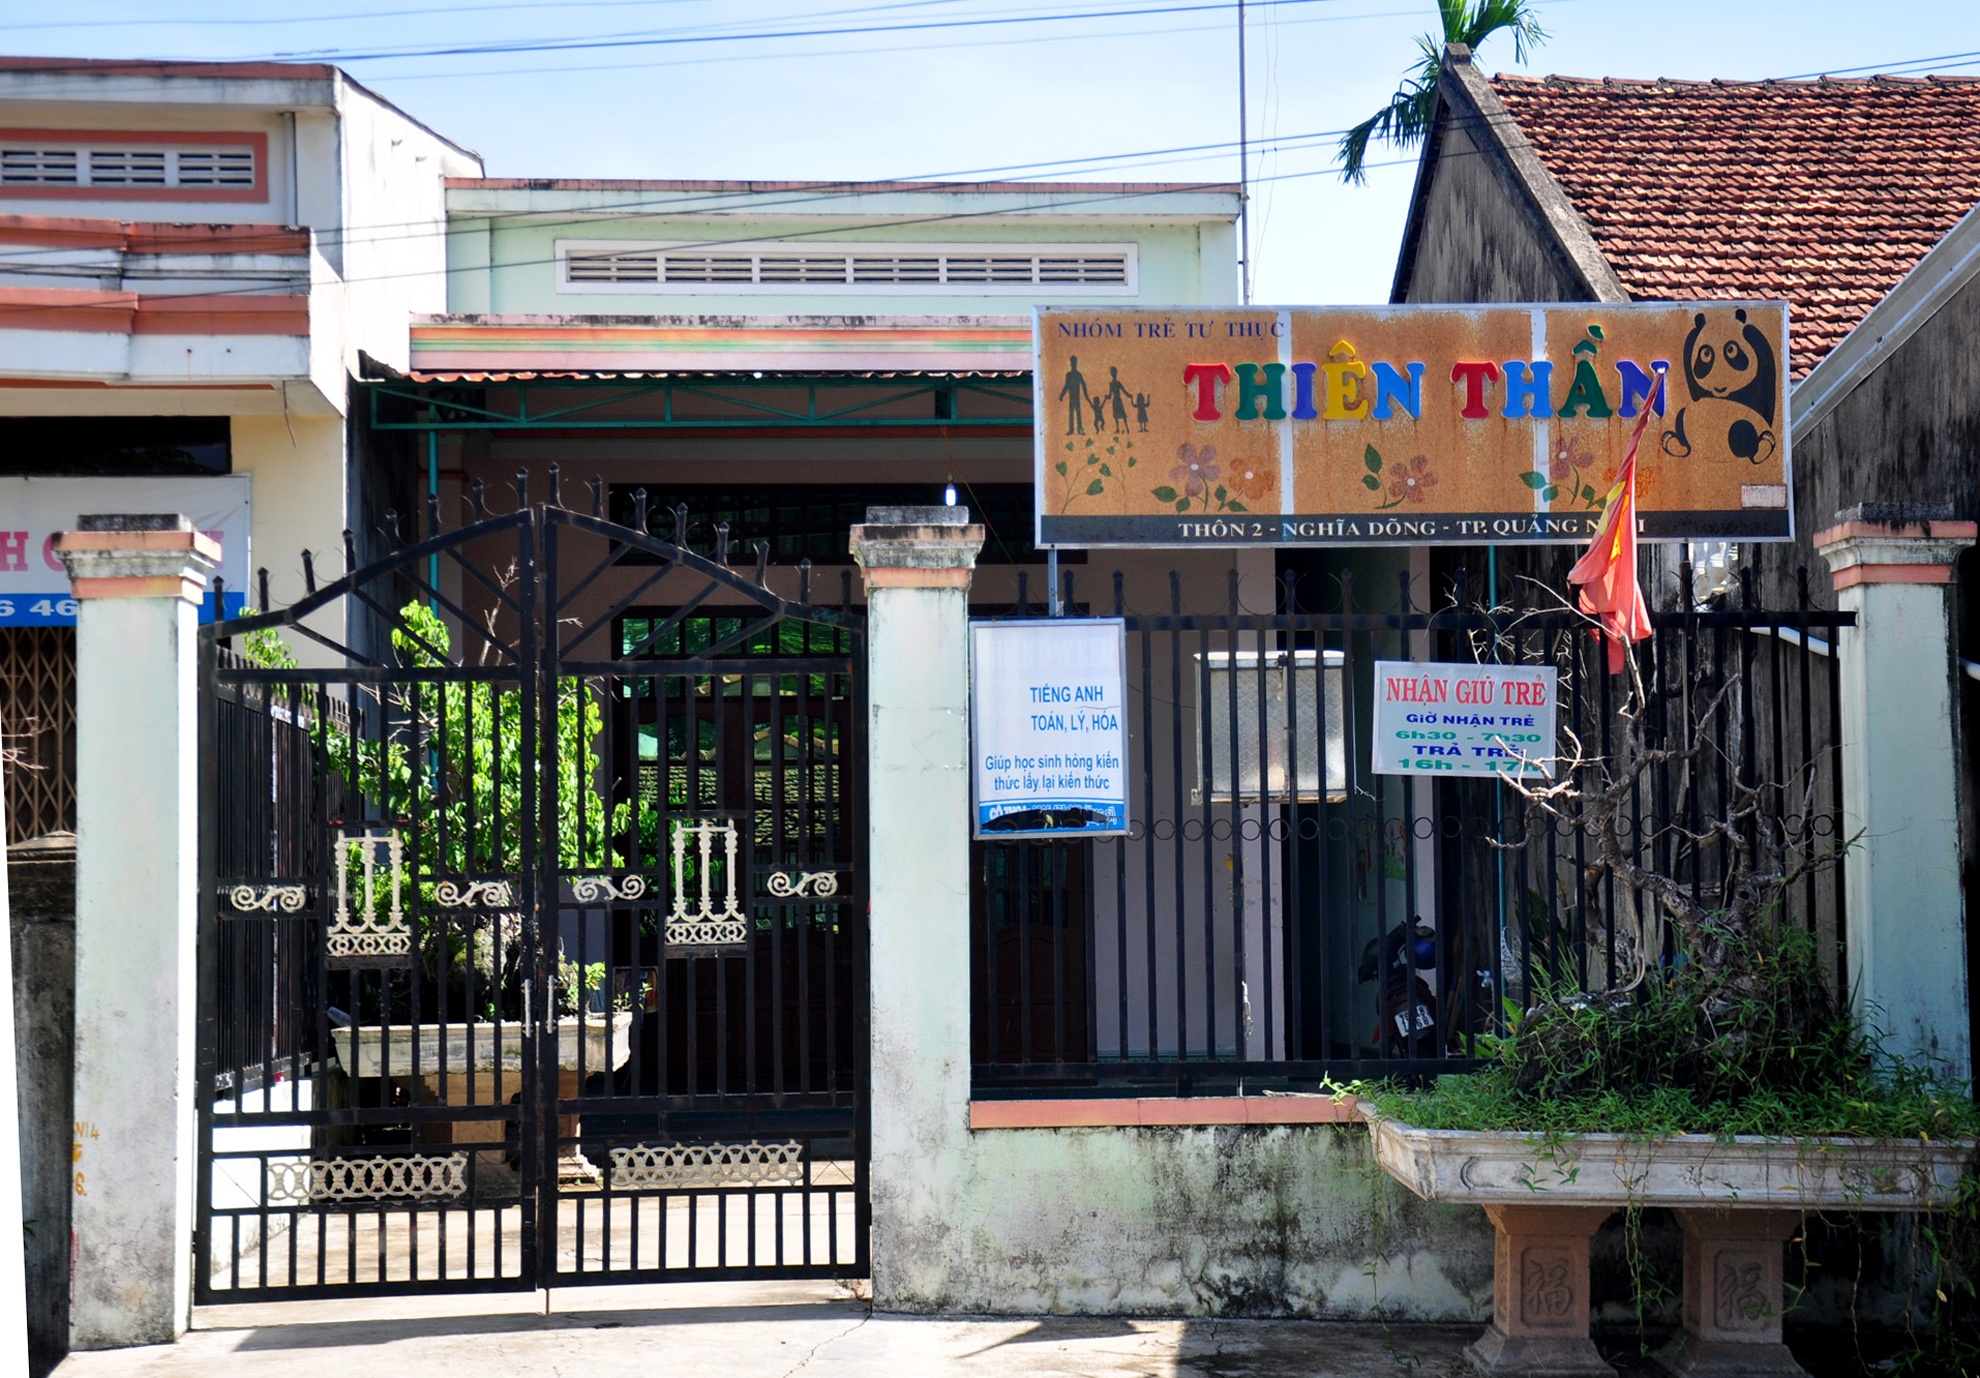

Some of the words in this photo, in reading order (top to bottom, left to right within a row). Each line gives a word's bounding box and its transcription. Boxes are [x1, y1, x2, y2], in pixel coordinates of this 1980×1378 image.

[1058, 317, 1122, 338] NHÓM
[1134, 317, 1176, 338] TRẺ
[1185, 320, 1214, 338] TƯ
[1225, 322, 1285, 340] THỤC
[1183, 340, 1426, 421] THIÊN
[1178, 519, 1245, 538] THÔN
[1251, 522, 1263, 537] 2
[1282, 519, 1360, 538] NGHĨA
[1367, 518, 1436, 536] DÕNG
[1456, 520, 1488, 534] TP.
[1493, 514, 1578, 536] QUẢNG
[1586, 519, 1645, 533] NI
[1074, 686, 1104, 702] ANH
[1386, 674, 1449, 707] NHẬN
[1455, 676, 1496, 704] GIỮ
[1501, 674, 1547, 706] TRẺ
[1031, 711, 1068, 733] TOÁN,
[1071, 710, 1089, 732] LÝ,
[1092, 710, 1119, 731] HÓA
[1443, 713, 1495, 728] NHẬN
[1500, 713, 1535, 727] TRẺ
[1395, 730, 1457, 740] 6h30
[1481, 733, 1542, 743] 7h30
[1412, 743, 1463, 756] TRẢ
[985, 755, 1012, 773] Giúp
[1014, 755, 1035, 773] học
[1038, 754, 1062, 769] sinh
[1096, 750, 1119, 769] kiến
[1398, 758, 1453, 771] 16h
[994, 776, 1020, 791] thức
[1023, 771, 1039, 792] lấy
[1042, 774, 1055, 792] lại
[1058, 770, 1081, 789] kiến
[1084, 774, 1110, 789] thức
